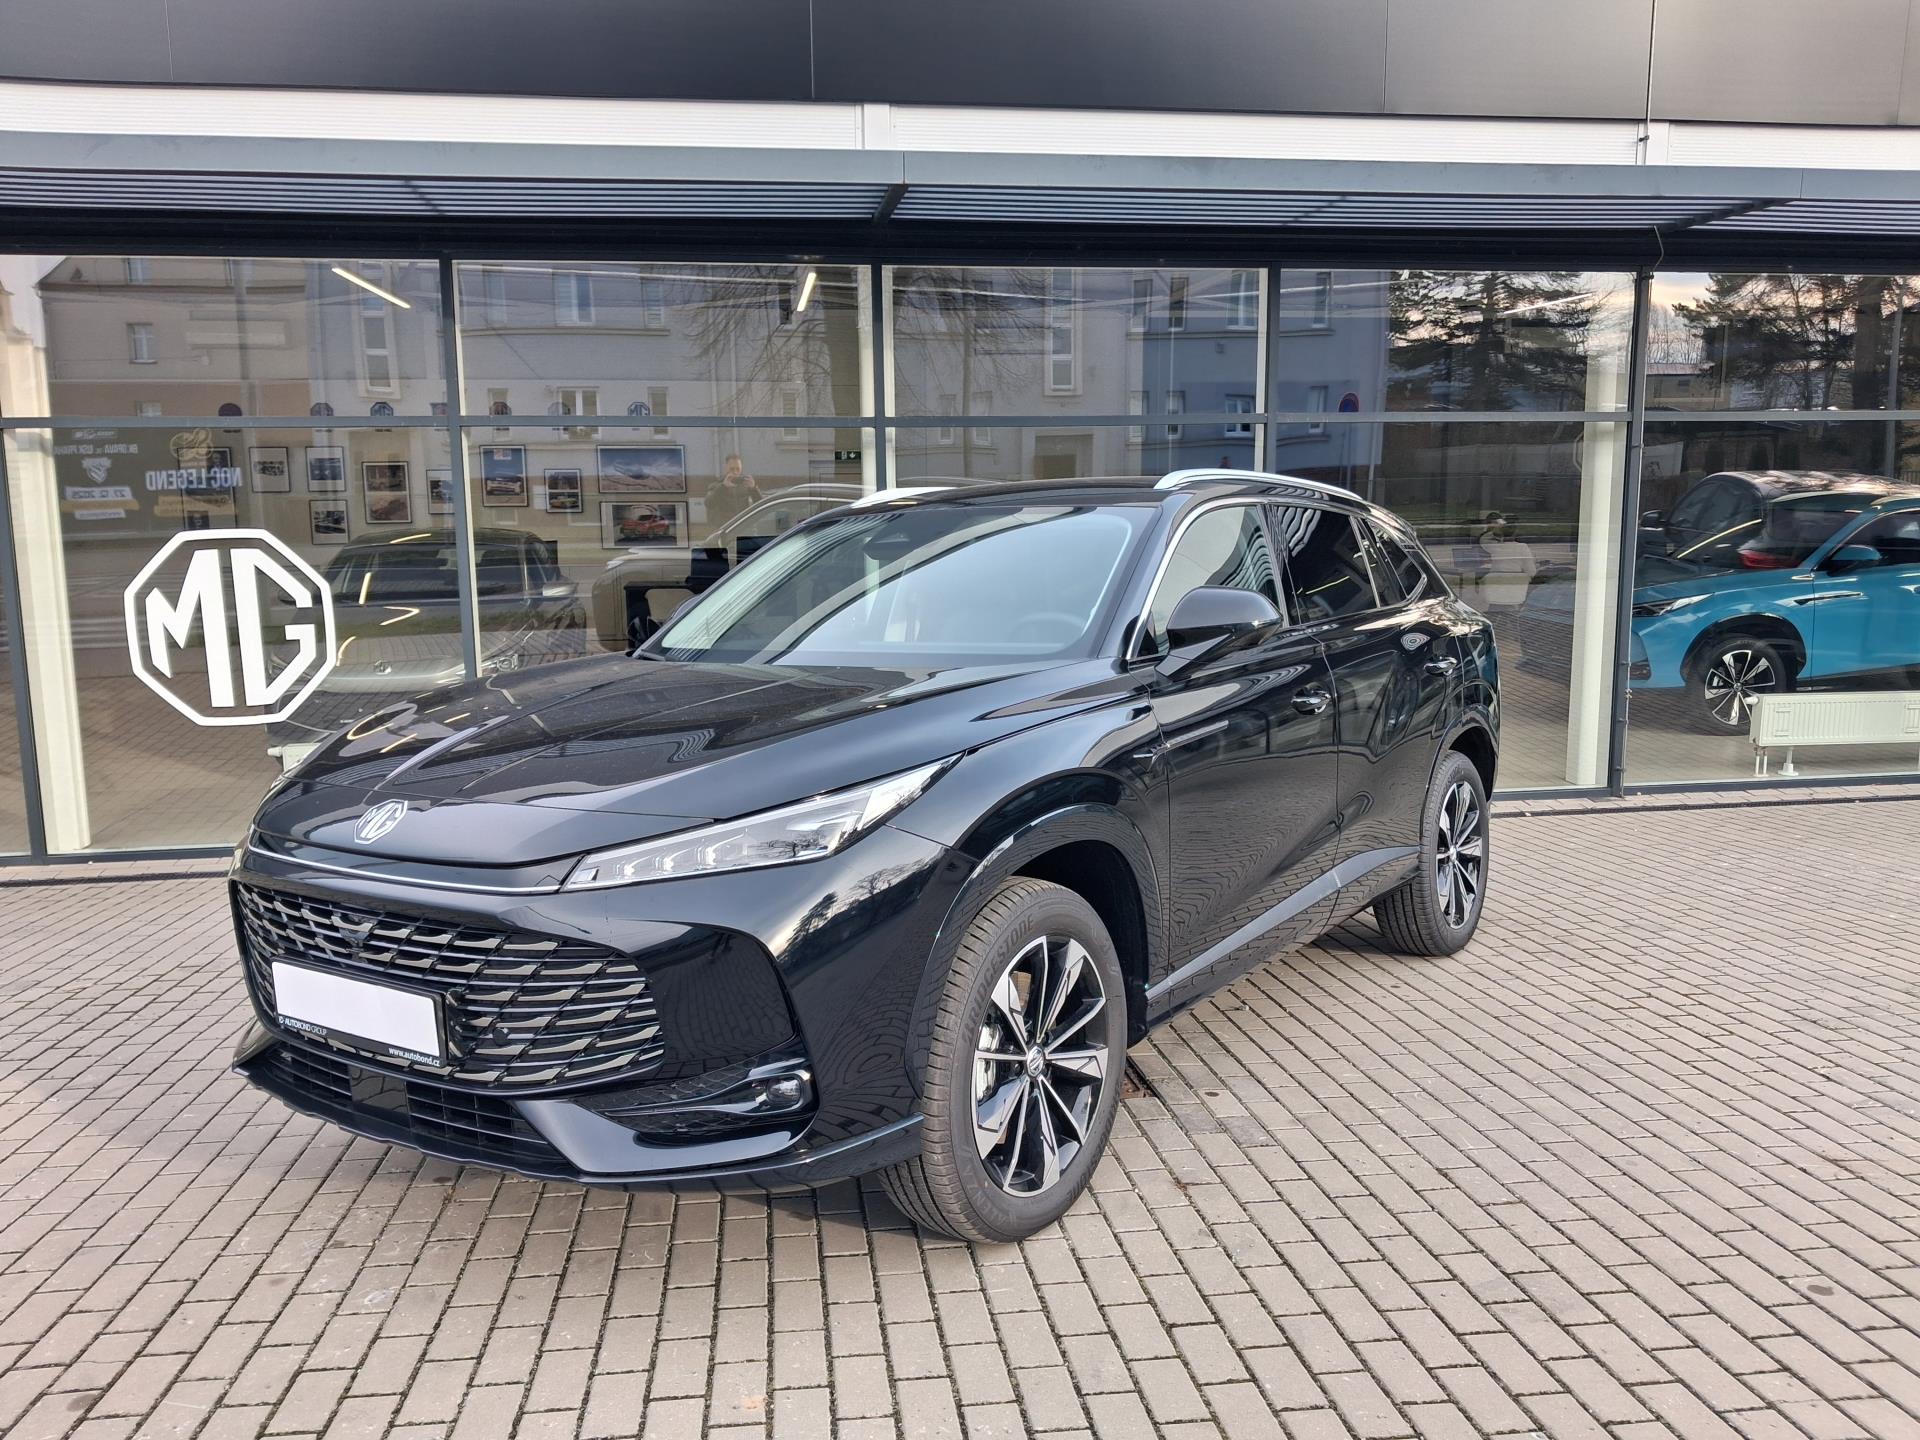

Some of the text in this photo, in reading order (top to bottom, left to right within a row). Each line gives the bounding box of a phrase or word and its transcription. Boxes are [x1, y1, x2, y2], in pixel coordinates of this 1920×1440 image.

[145, 548, 316, 707] MG
[356, 800, 406, 842] MG
[963, 912, 1035, 1043] BRIDGESTONE
[284, 1017, 327, 1036] AUTOBOND GROUP
[388, 1046, 441, 1067] www.autobond.cz
